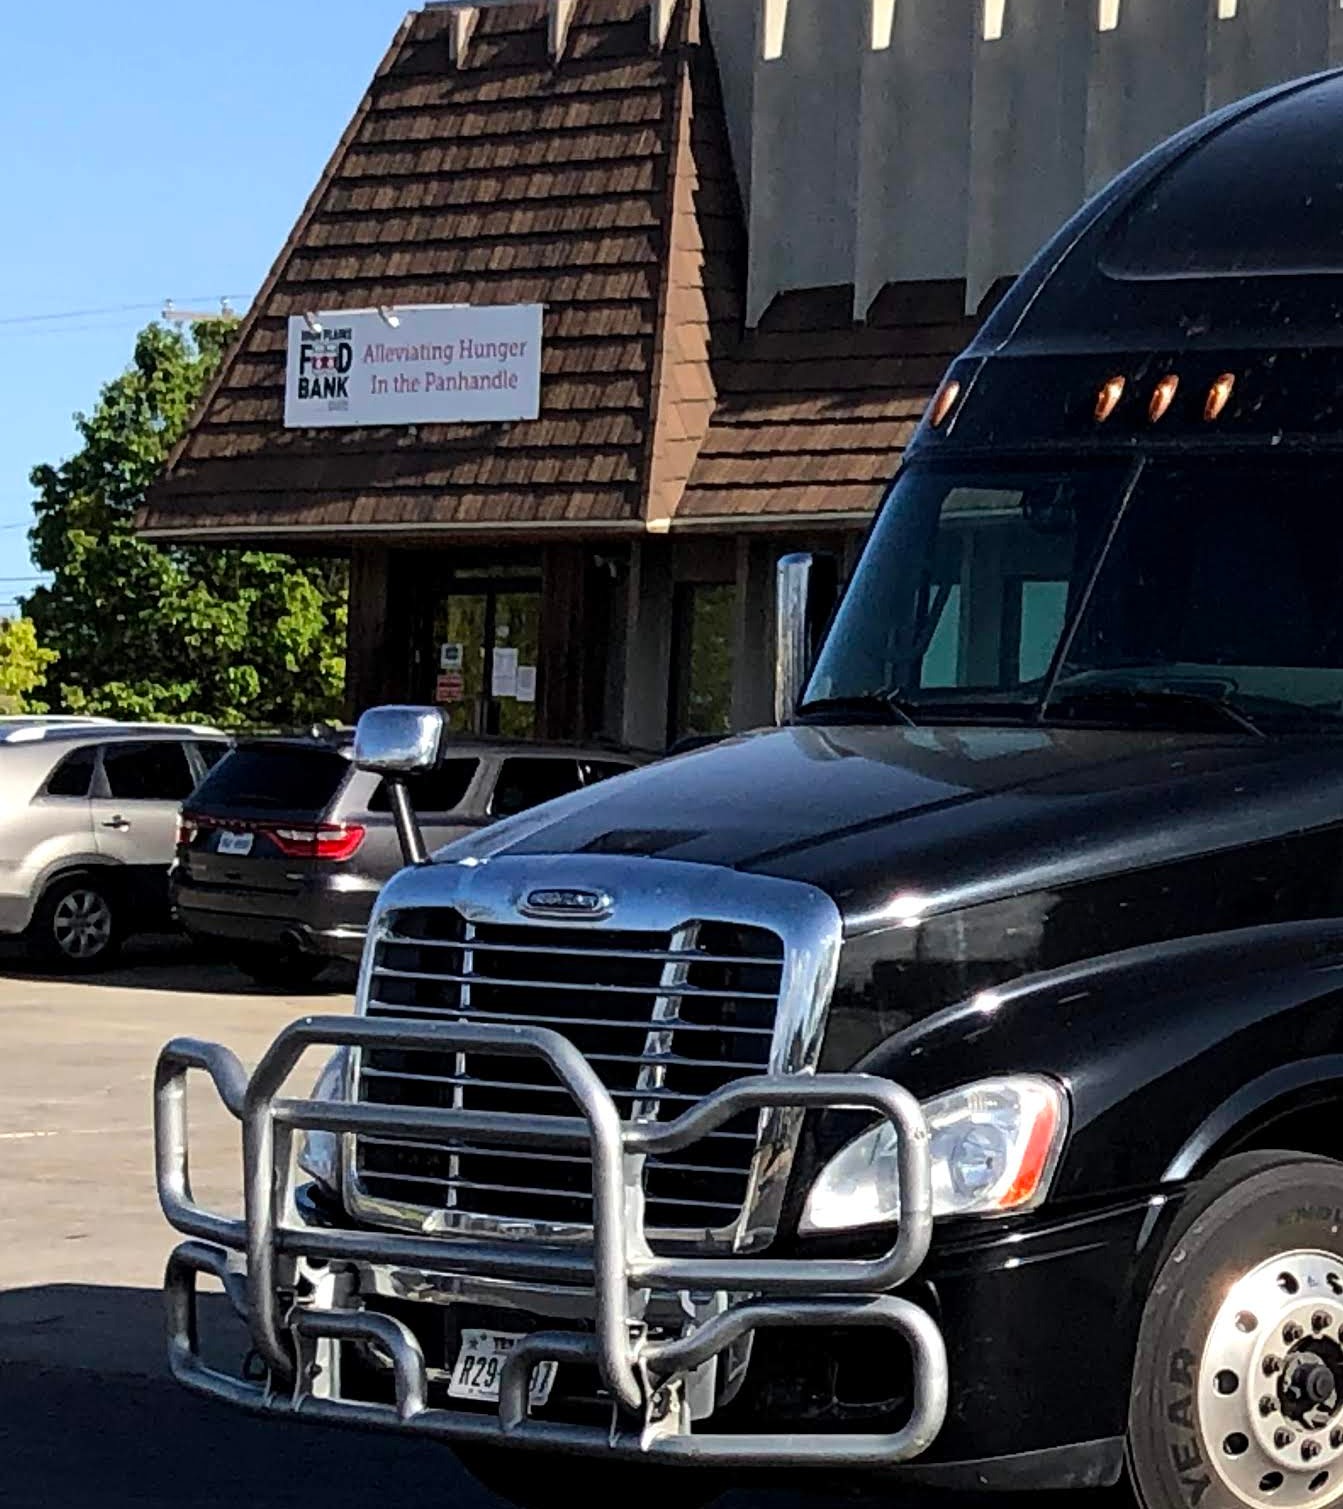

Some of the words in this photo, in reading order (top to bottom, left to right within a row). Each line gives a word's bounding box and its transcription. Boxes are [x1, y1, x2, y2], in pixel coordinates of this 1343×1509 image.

[363, 343, 453, 366] Alleviating
[459, 339, 528, 363] Hunger
[298, 376, 349, 399] BANK
[371, 375, 388, 394] In
[393, 374, 419, 393] the
[424, 370, 518, 392] Panhandle
